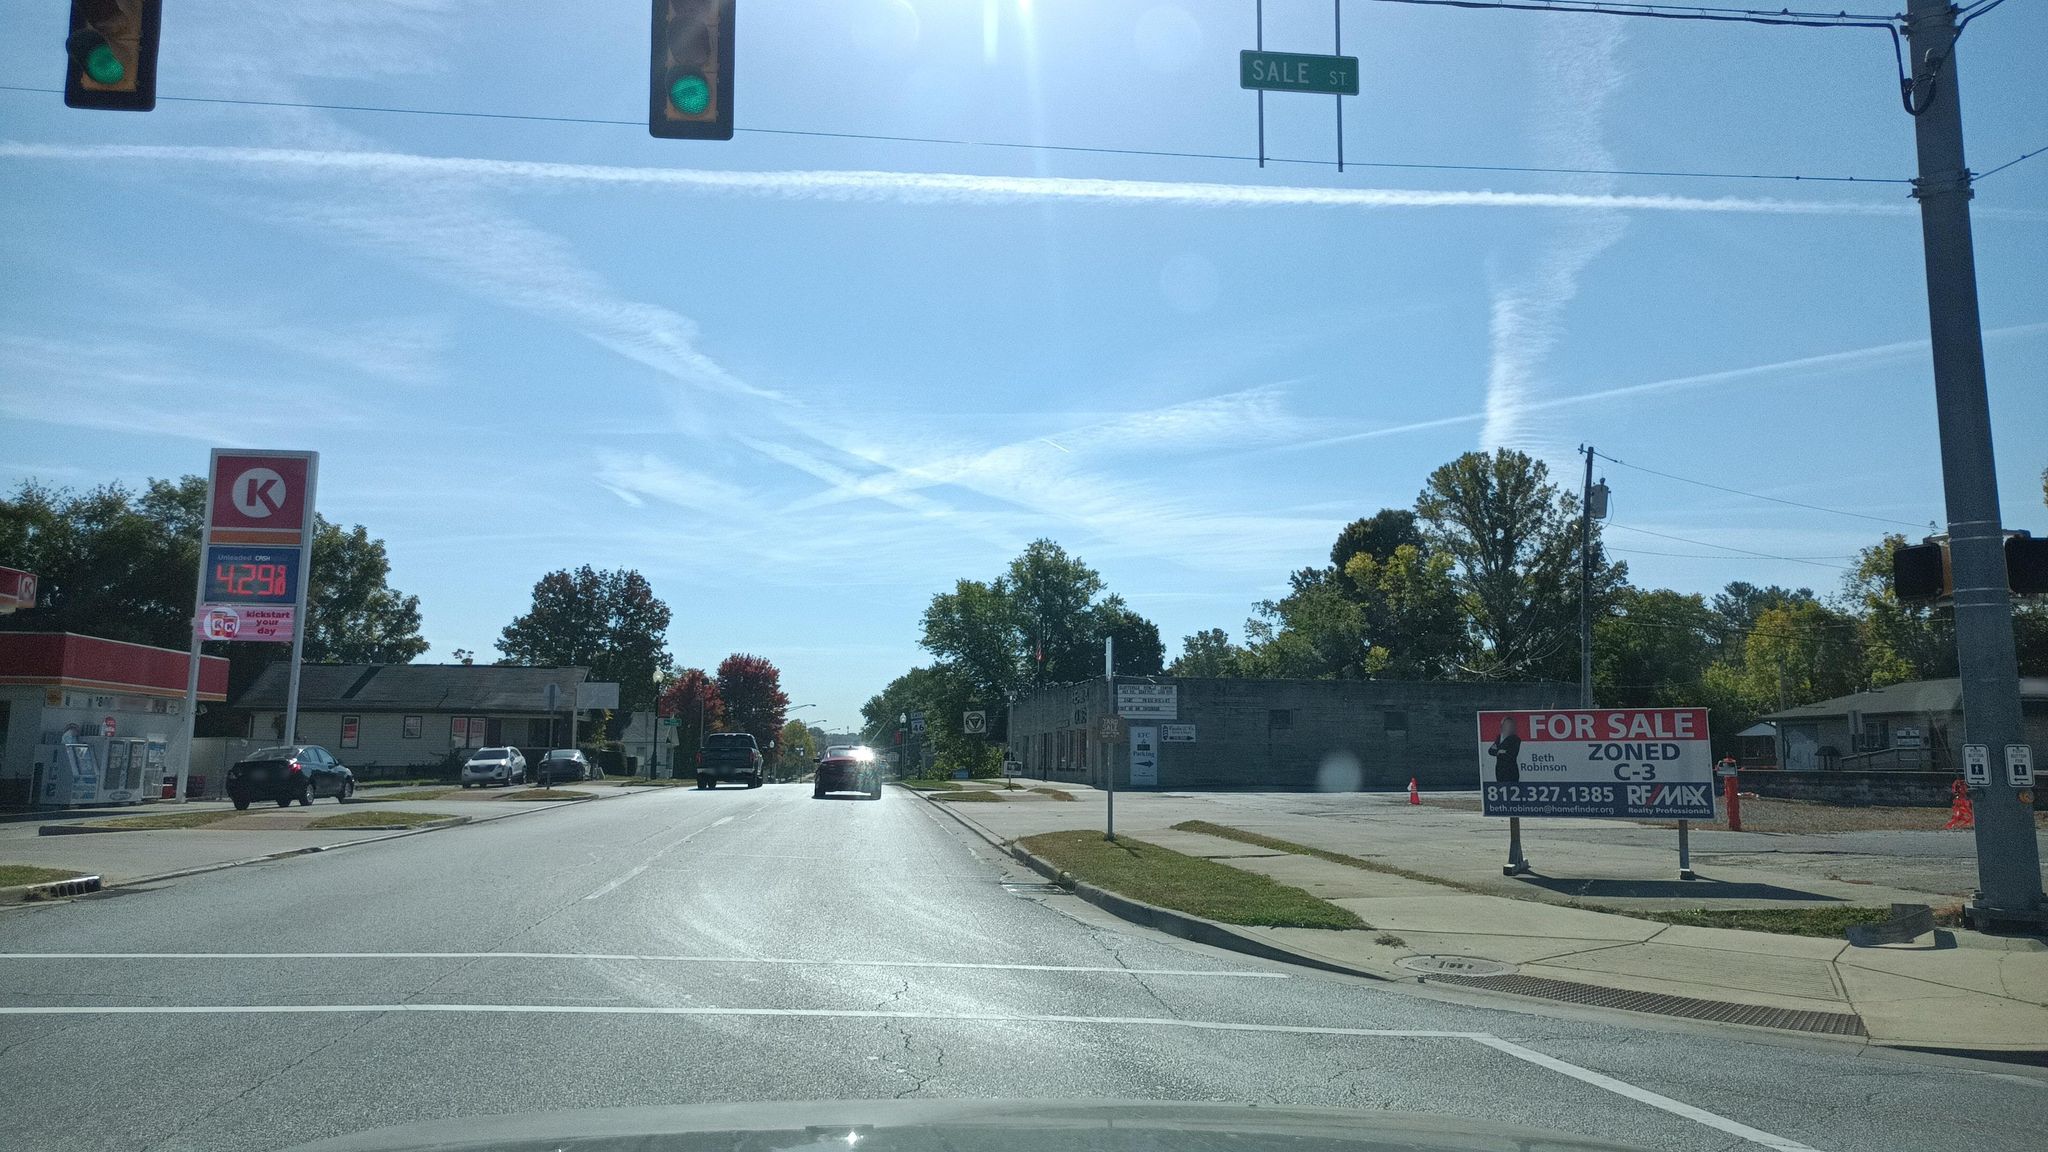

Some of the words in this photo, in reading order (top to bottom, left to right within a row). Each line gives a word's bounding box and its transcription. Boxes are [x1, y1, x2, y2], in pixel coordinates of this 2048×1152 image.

[1252, 60, 1310, 84] SALE
[246, 479, 281, 514] K
[24, 581, 33, 593] K
[214, 620, 222, 629] K
[226, 623, 234, 631] K
[256, 619, 279, 627] your
[257, 627, 276, 636] day
[1529, 714, 1597, 739] FOR
[1607, 713, 1695, 738] SALE
[1588, 743, 1681, 761] ZONED
[1531, 753, 1555, 763] Beth
[1520, 763, 1567, 772] Robinson
[1613, 763, 1656, 781] C-3
[1487, 786, 1614, 802] 812.327.1385
[1627, 784, 1708, 806] RE/MAX
[1489, 804, 1615, 815] beth.robinson@homefinder.org
[1628, 807, 1654, 815] Realty
[1655, 807, 1711, 815] Professionals
